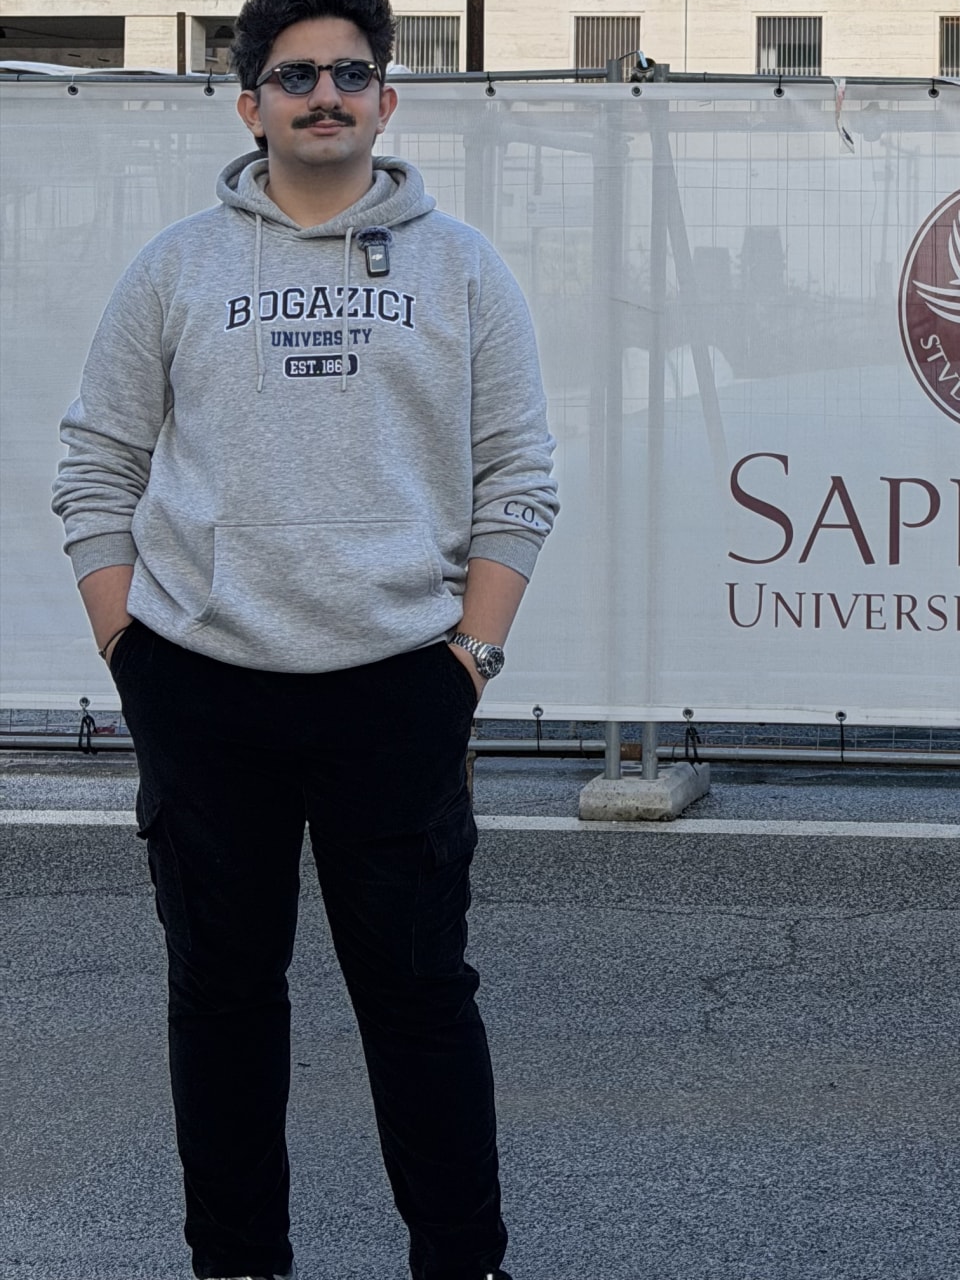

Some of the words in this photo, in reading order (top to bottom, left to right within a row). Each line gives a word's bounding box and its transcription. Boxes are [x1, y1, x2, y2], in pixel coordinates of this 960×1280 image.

[224, 285, 416, 332] BOGAZICI
[270, 327, 373, 348] UNIVERSTY
[289, 358, 352, 375] EST.186
